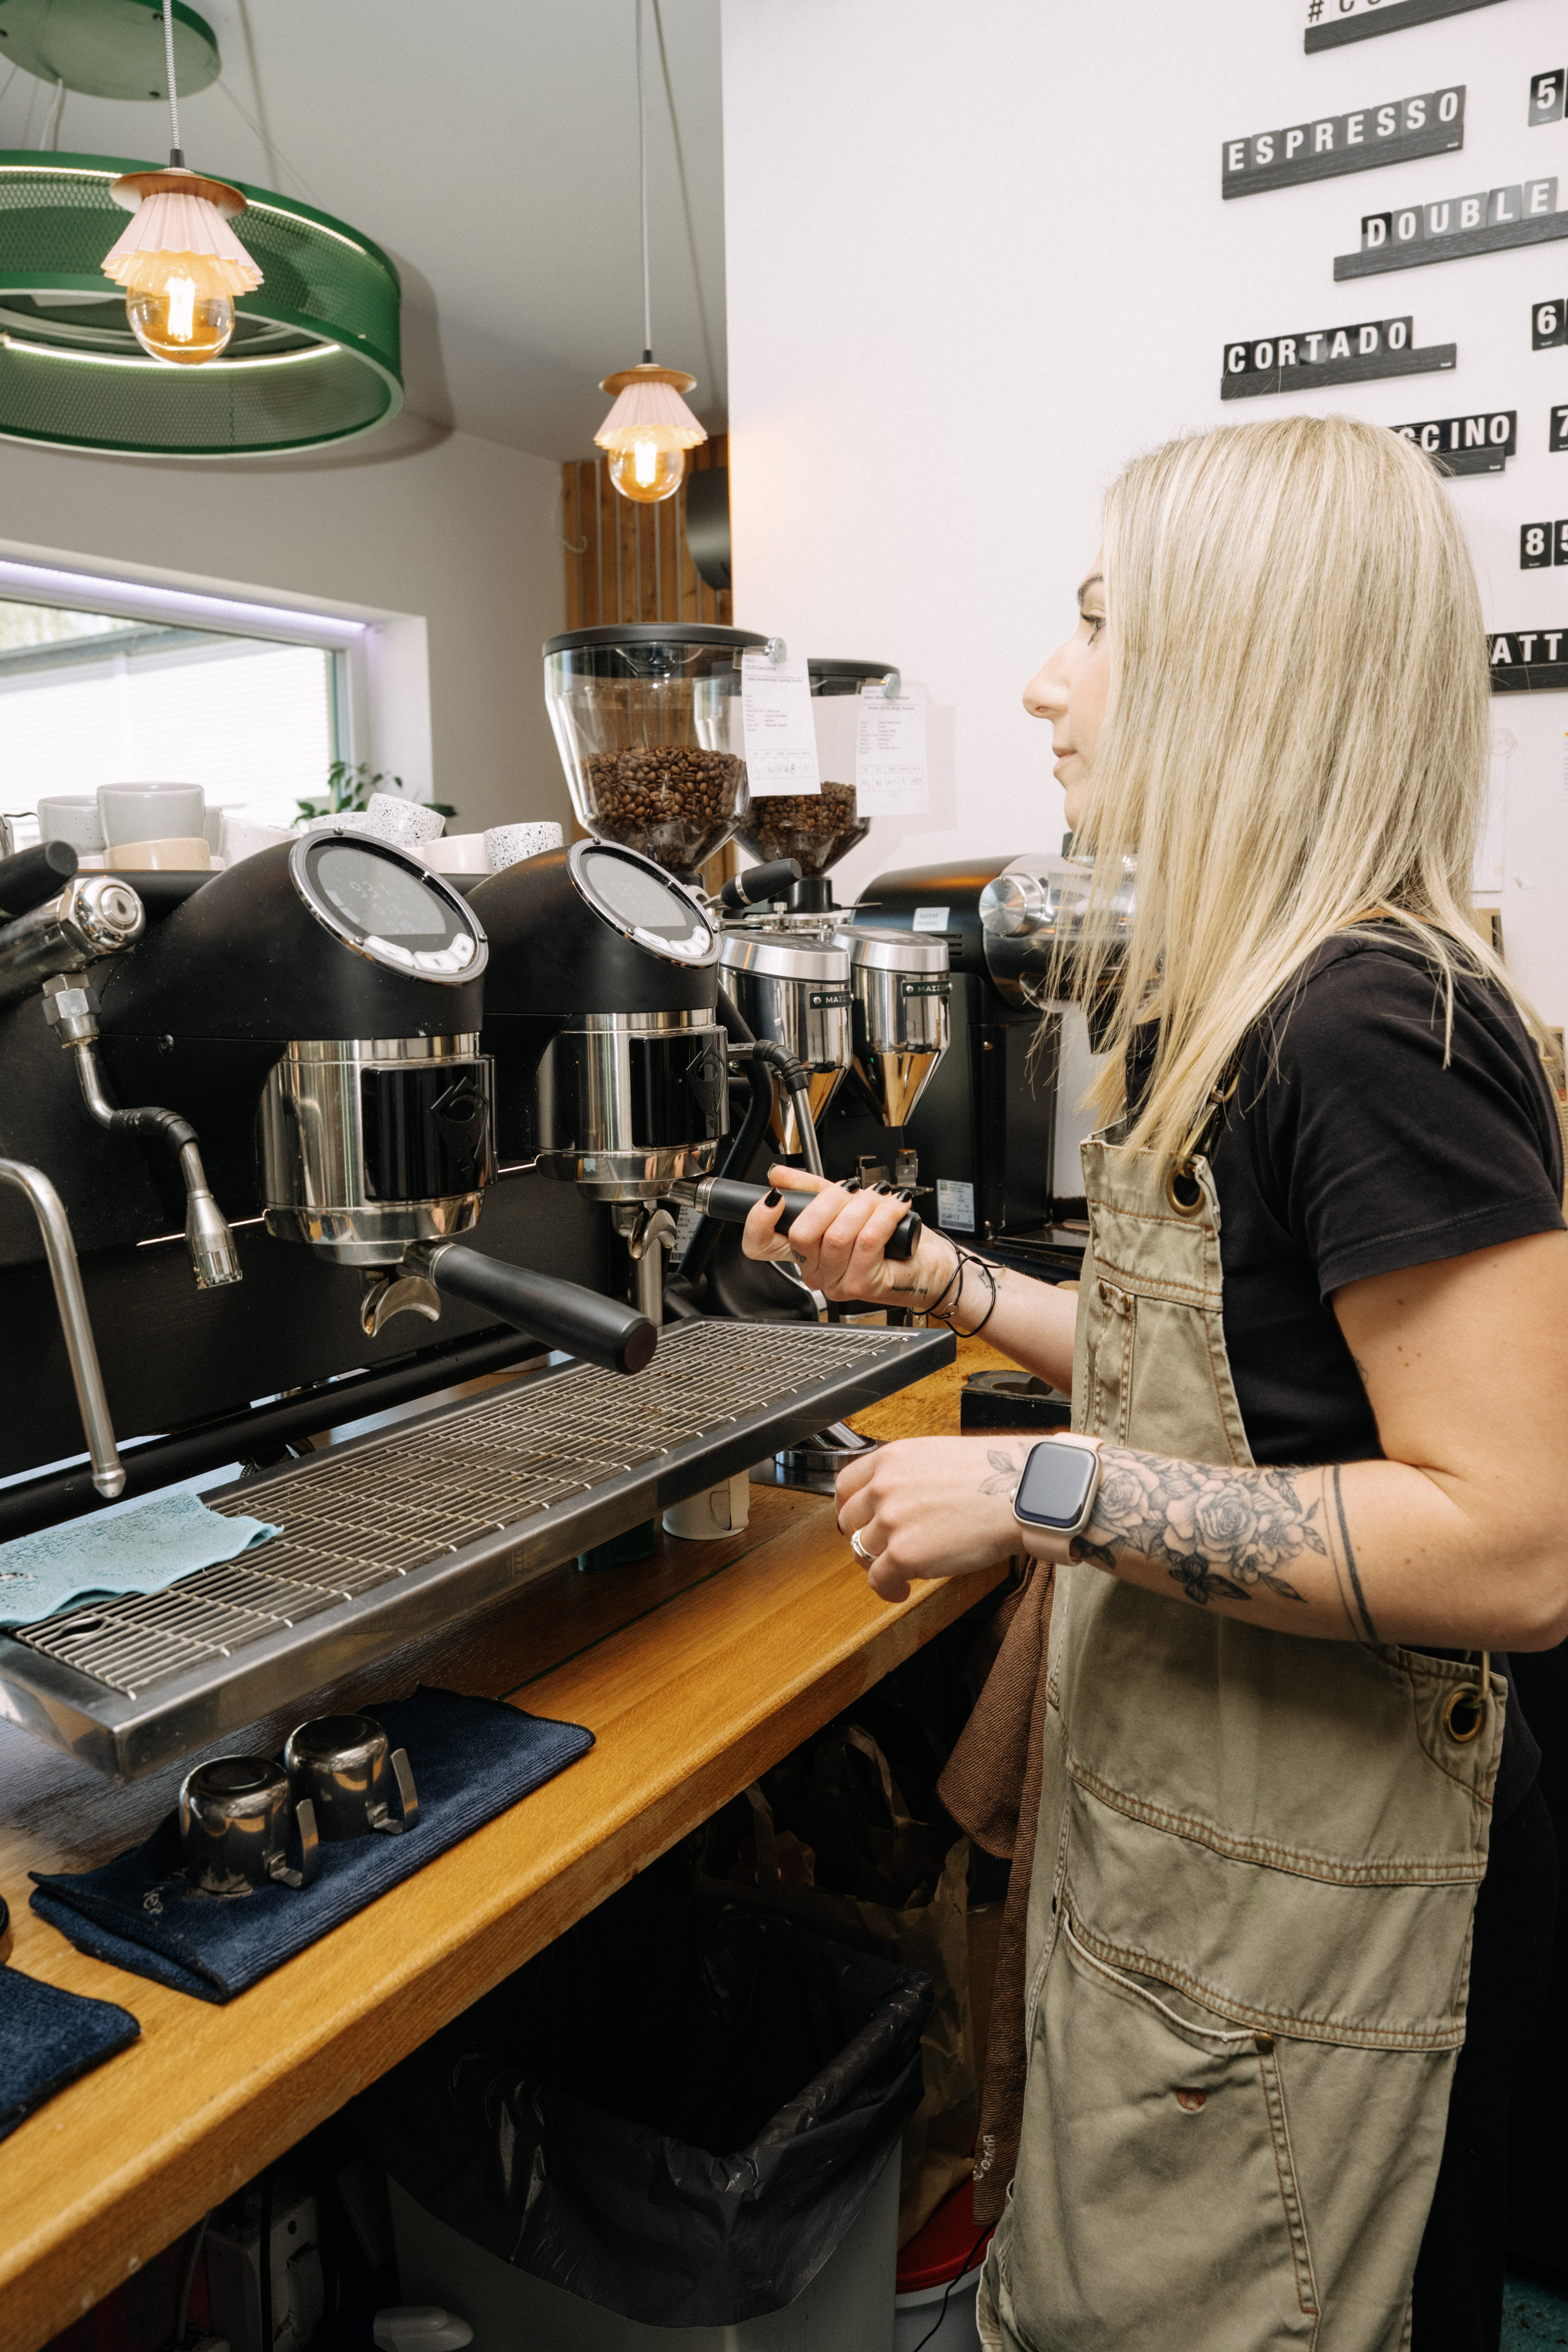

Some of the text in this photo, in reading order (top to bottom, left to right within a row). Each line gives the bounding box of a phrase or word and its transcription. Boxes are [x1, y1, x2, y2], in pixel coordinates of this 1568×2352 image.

[1228, 92, 1458, 171] ESPRESSO
[1367, 182, 1550, 248] DOUBLE
[1228, 321, 1407, 373] CORTADO
[1492, 632, 1563, 664] ATT
[826, 995, 850, 1004] MAZZ
